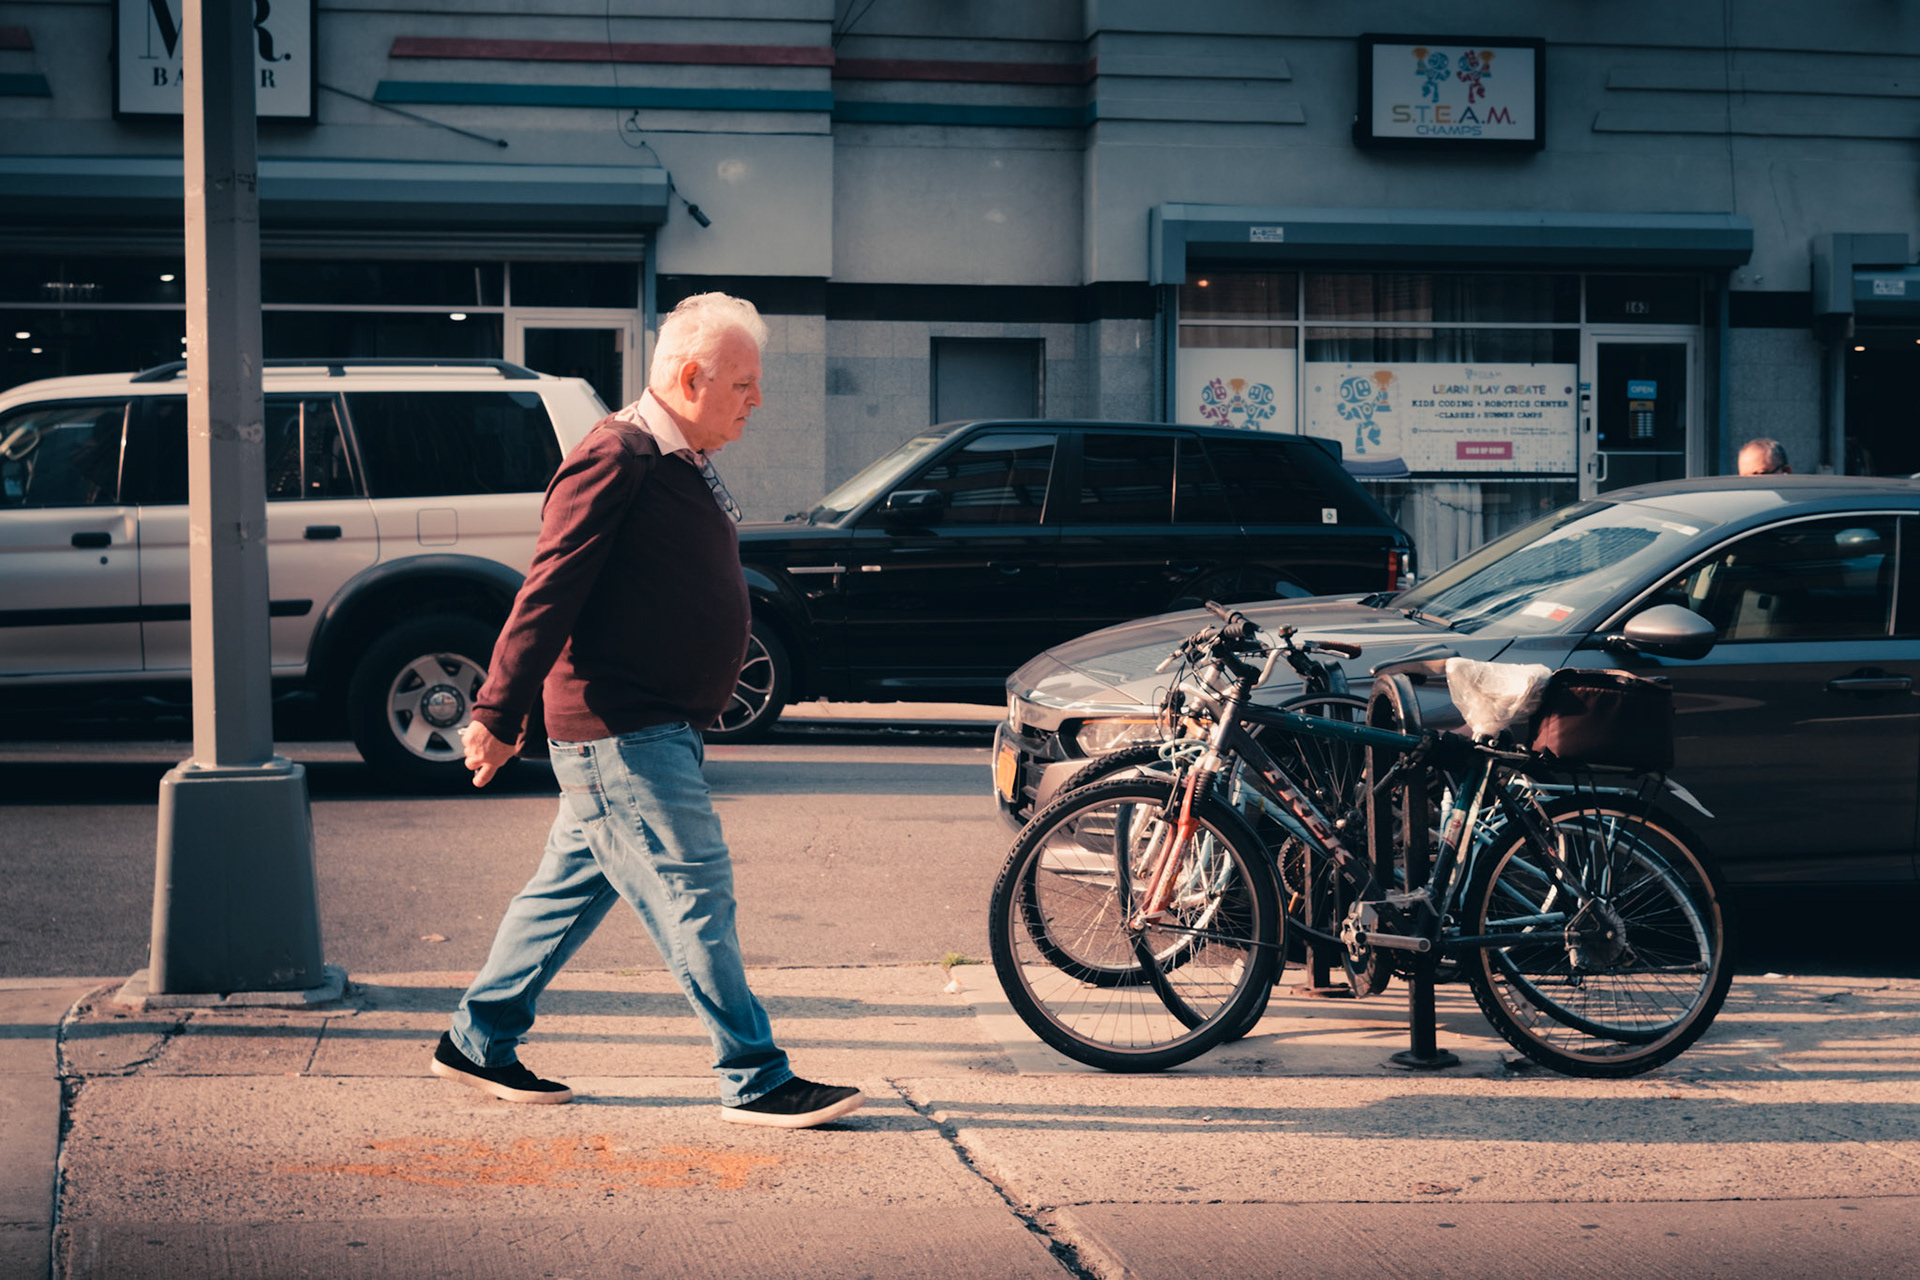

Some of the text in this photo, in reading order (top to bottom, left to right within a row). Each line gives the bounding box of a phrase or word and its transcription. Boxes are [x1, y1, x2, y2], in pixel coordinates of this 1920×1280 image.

[1392, 104, 1516, 125] S.T.E.A.M.
[1416, 124, 1482, 136] CHAMPS
[1432, 384, 1547, 395] LEARN PLAY CREATE
[1630, 385, 1655, 394] OPEN
[1484, 400, 1530, 408] ROBOTICS
[1534, 400, 1569, 408] CENTER
[1262, 761, 1355, 867] TREK
